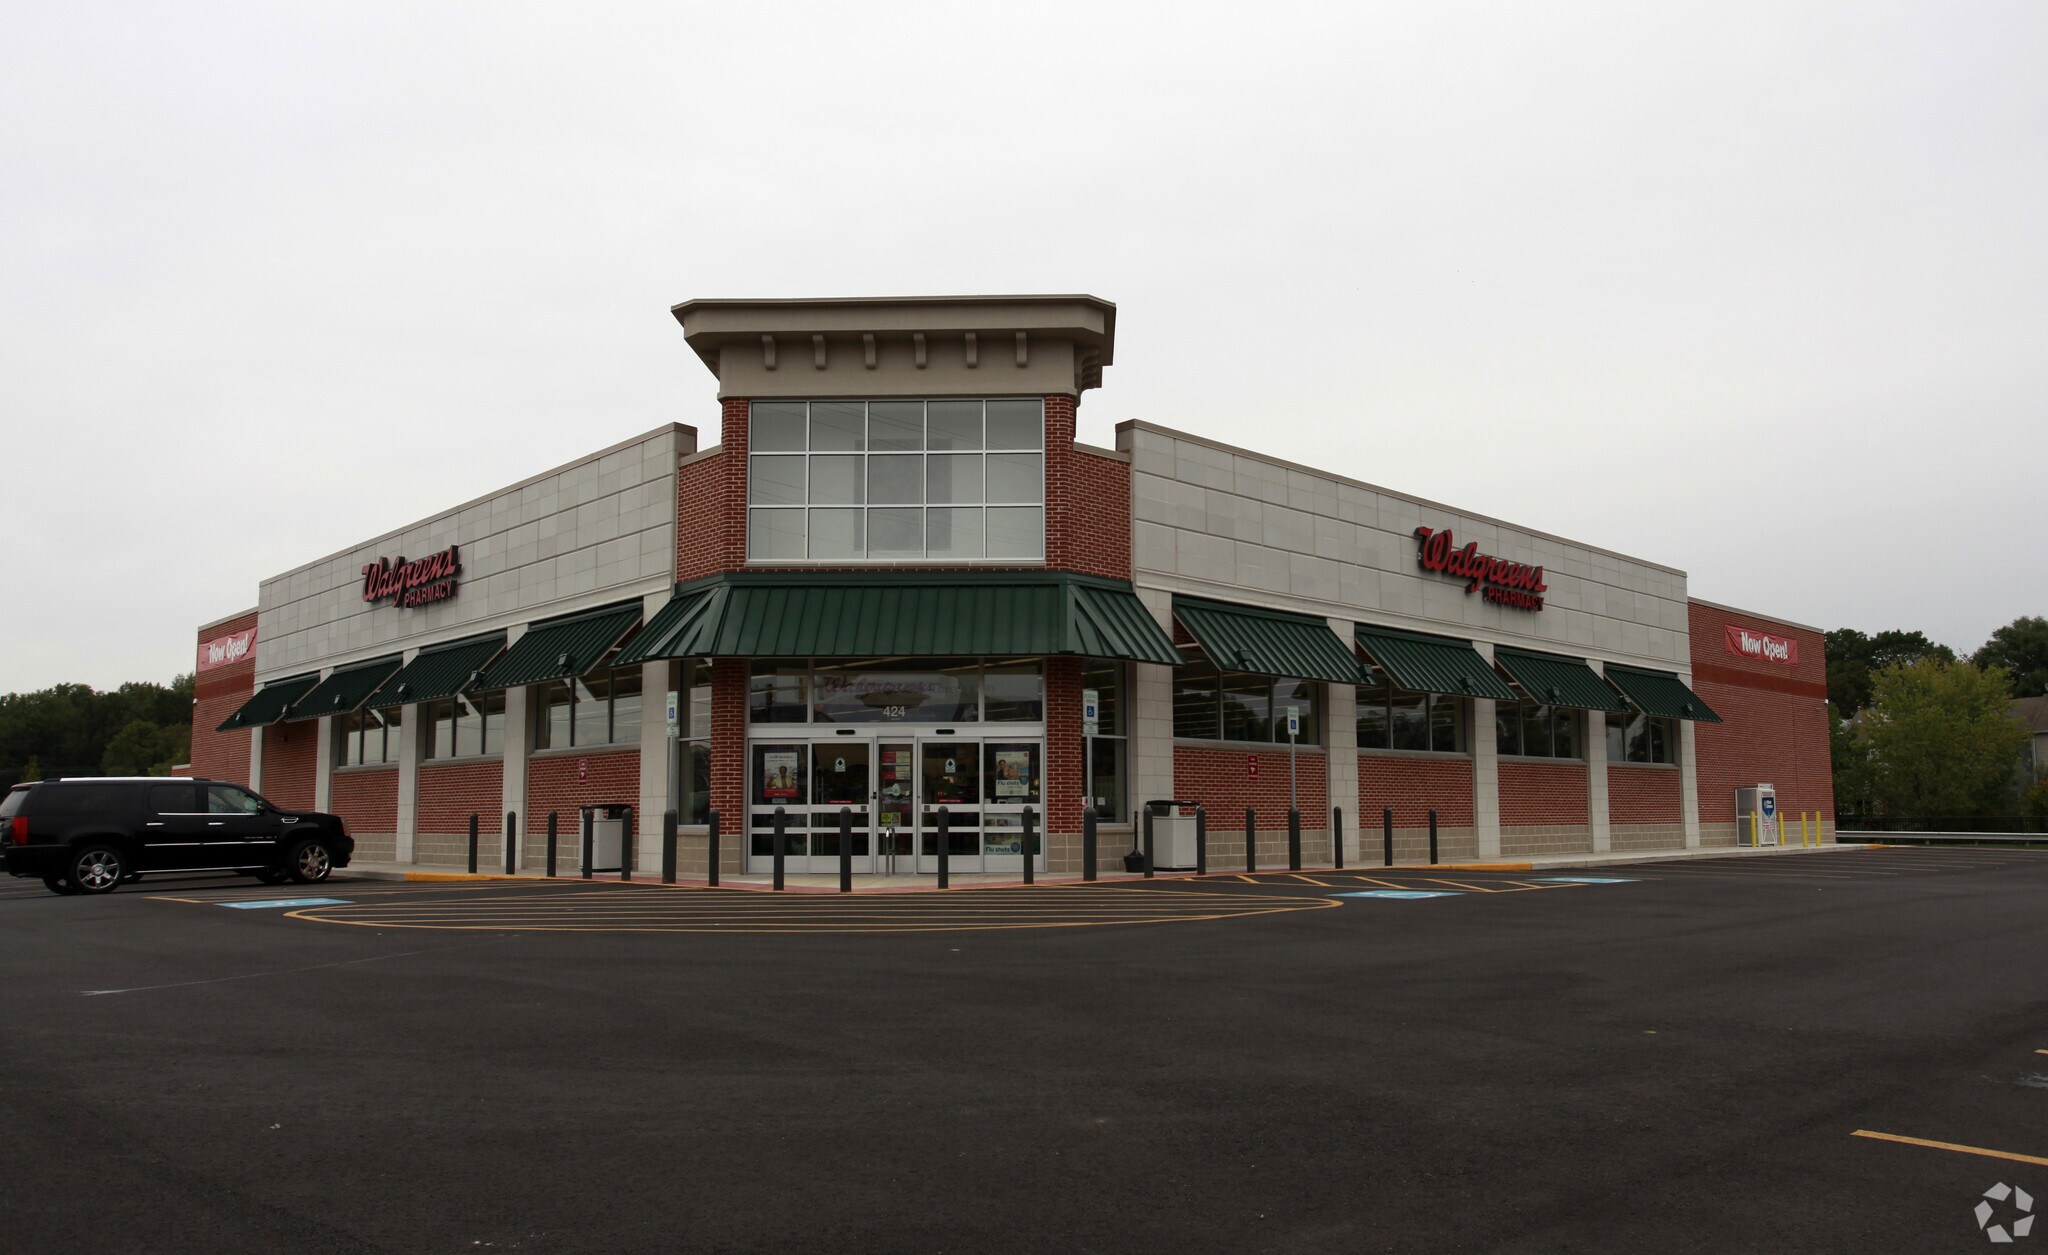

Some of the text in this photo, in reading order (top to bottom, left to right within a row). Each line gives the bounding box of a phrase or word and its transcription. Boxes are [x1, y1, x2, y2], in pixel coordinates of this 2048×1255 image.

[1415, 526, 1547, 593] Walgreens
[362, 545, 461, 608] Walgreens
[404, 581, 456, 608] PHARMACY
[1486, 586, 1544, 611] PHARMACY
[209, 633, 249, 664] Now Open!
[1741, 632, 1788, 660] Now Open!
[883, 706, 906, 717] 424
